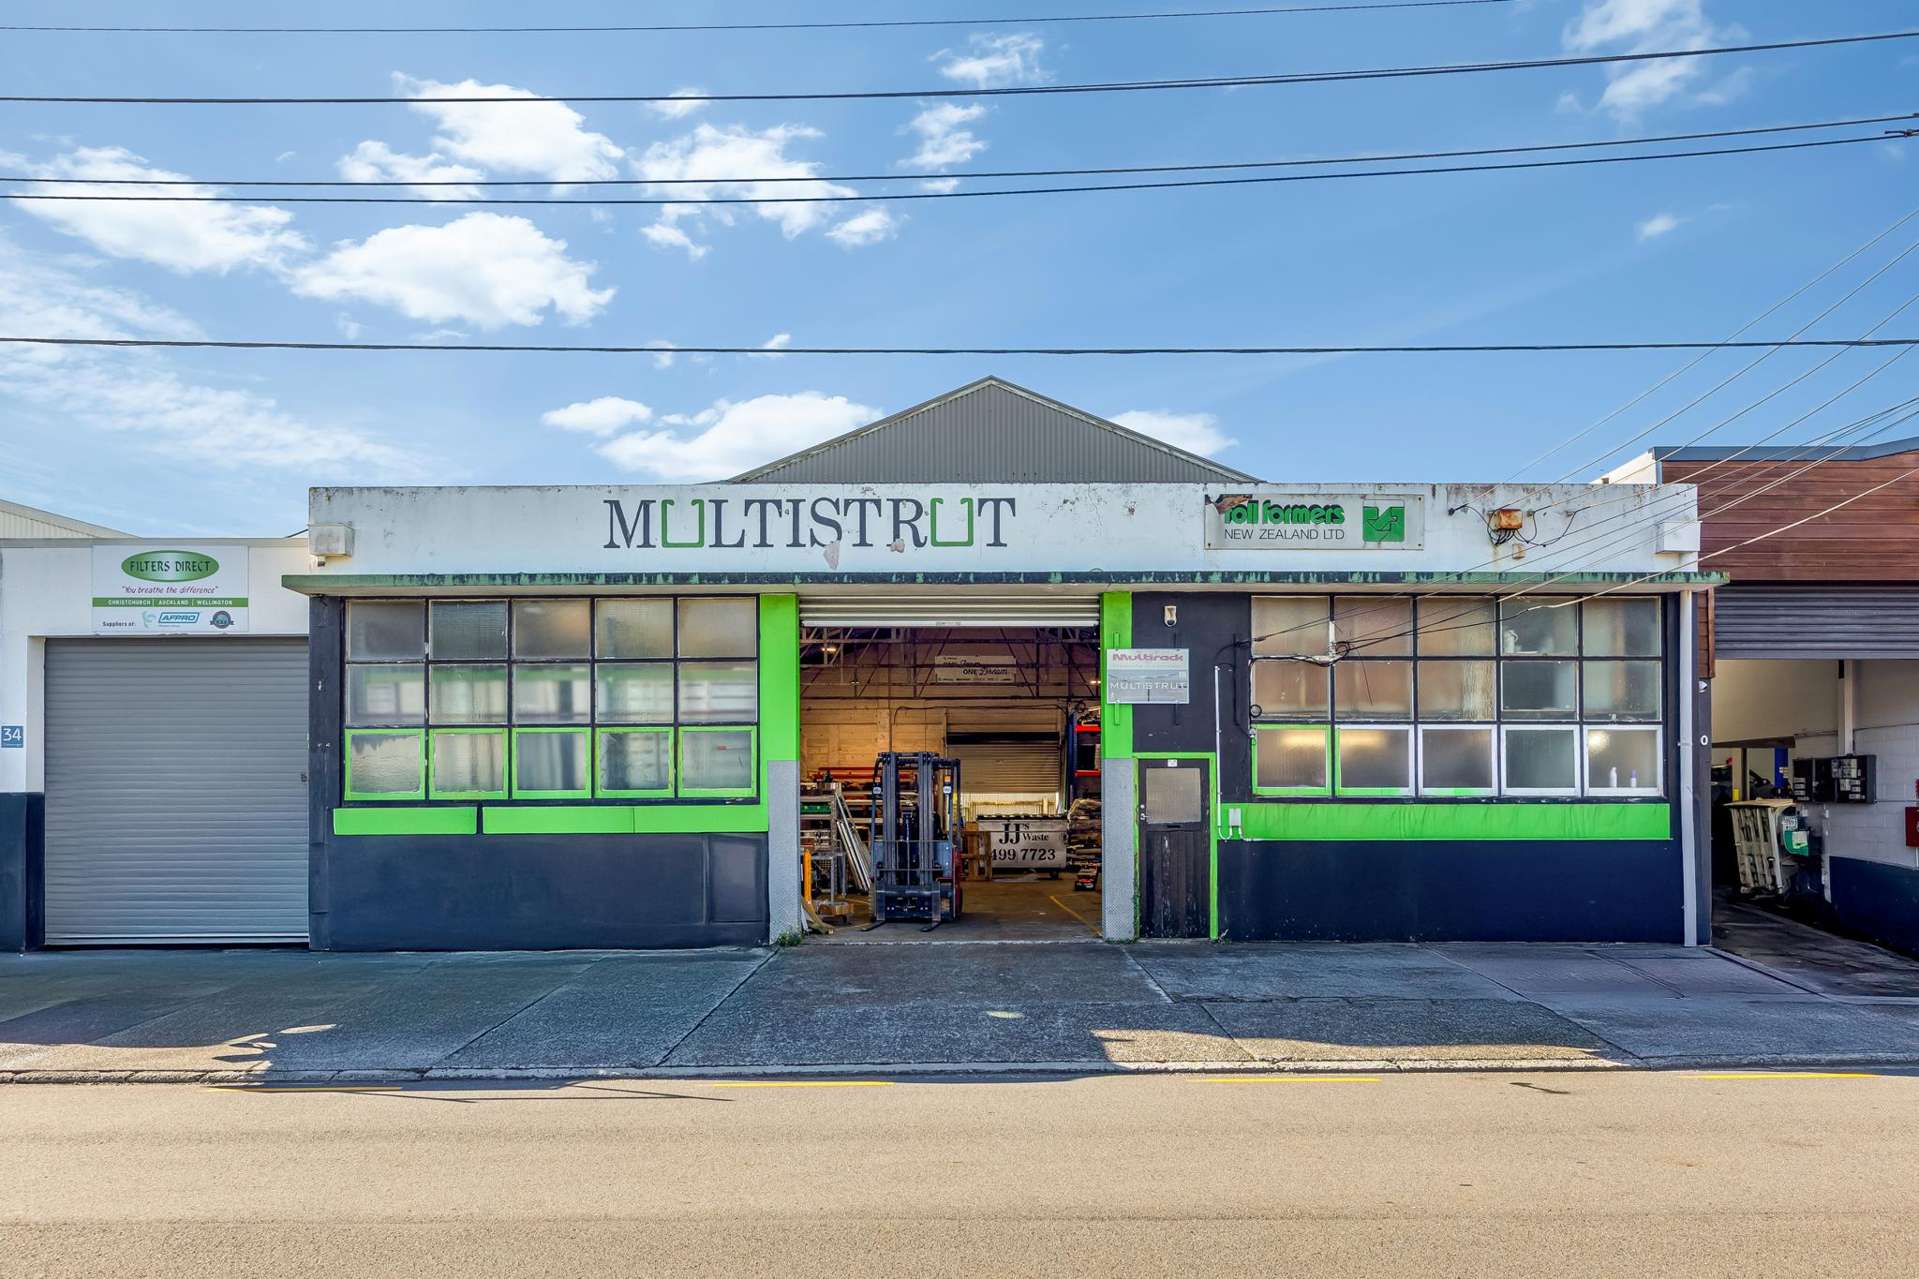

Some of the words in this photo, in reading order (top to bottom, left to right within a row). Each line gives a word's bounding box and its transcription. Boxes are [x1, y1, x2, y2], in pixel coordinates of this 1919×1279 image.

[602, 497, 1016, 549] MULTISTRUT
[1224, 528, 1254, 540] NEW
[1259, 528, 1319, 540] ZEALAND
[1323, 528, 1345, 540] LTD
[129, 560, 170, 572] FILTERS
[175, 560, 211, 572] DIRECT
[138, 585, 164, 594] breathe
[166, 585, 178, 593] the
[1110, 681, 1187, 690] MULTISTRUT
[3, 727, 22, 741] 34
[1022, 832, 1049, 841] Waste
[1020, 848, 1056, 861] 7723
